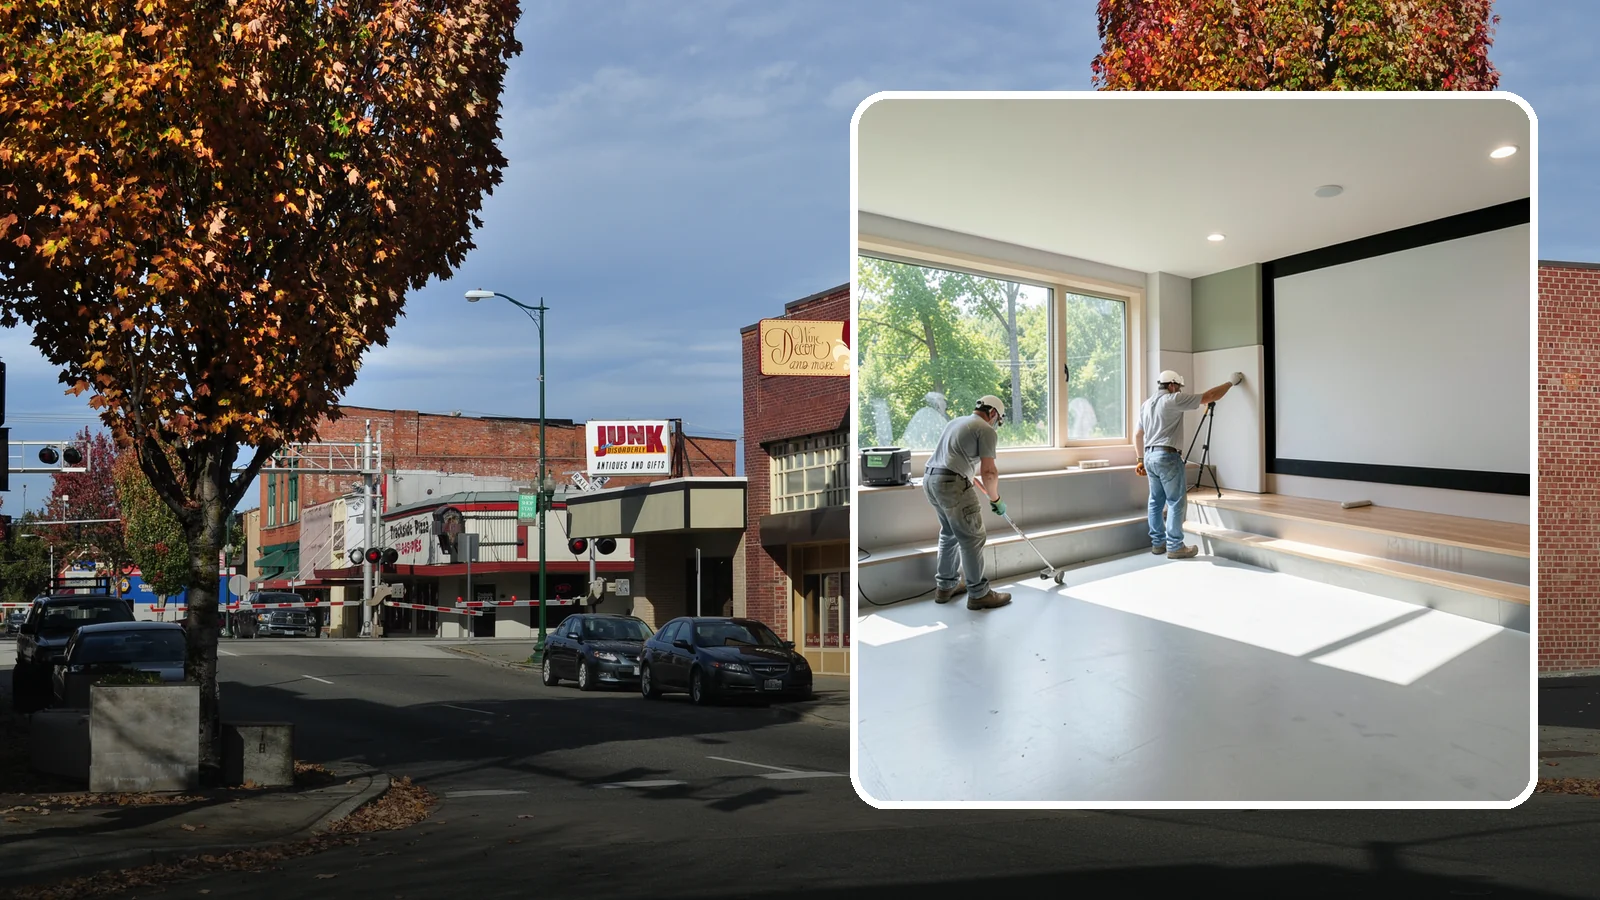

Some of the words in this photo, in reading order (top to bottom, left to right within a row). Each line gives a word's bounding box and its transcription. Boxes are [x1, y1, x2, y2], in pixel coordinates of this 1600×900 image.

[765, 328, 831, 366] Decor
[596, 425, 664, 457] JUNK
[597, 461, 628, 470] ANTIQUES
[631, 461, 644, 470] AND
[647, 460, 665, 470] GIFTS
[414, 519, 429, 534] Pizza
